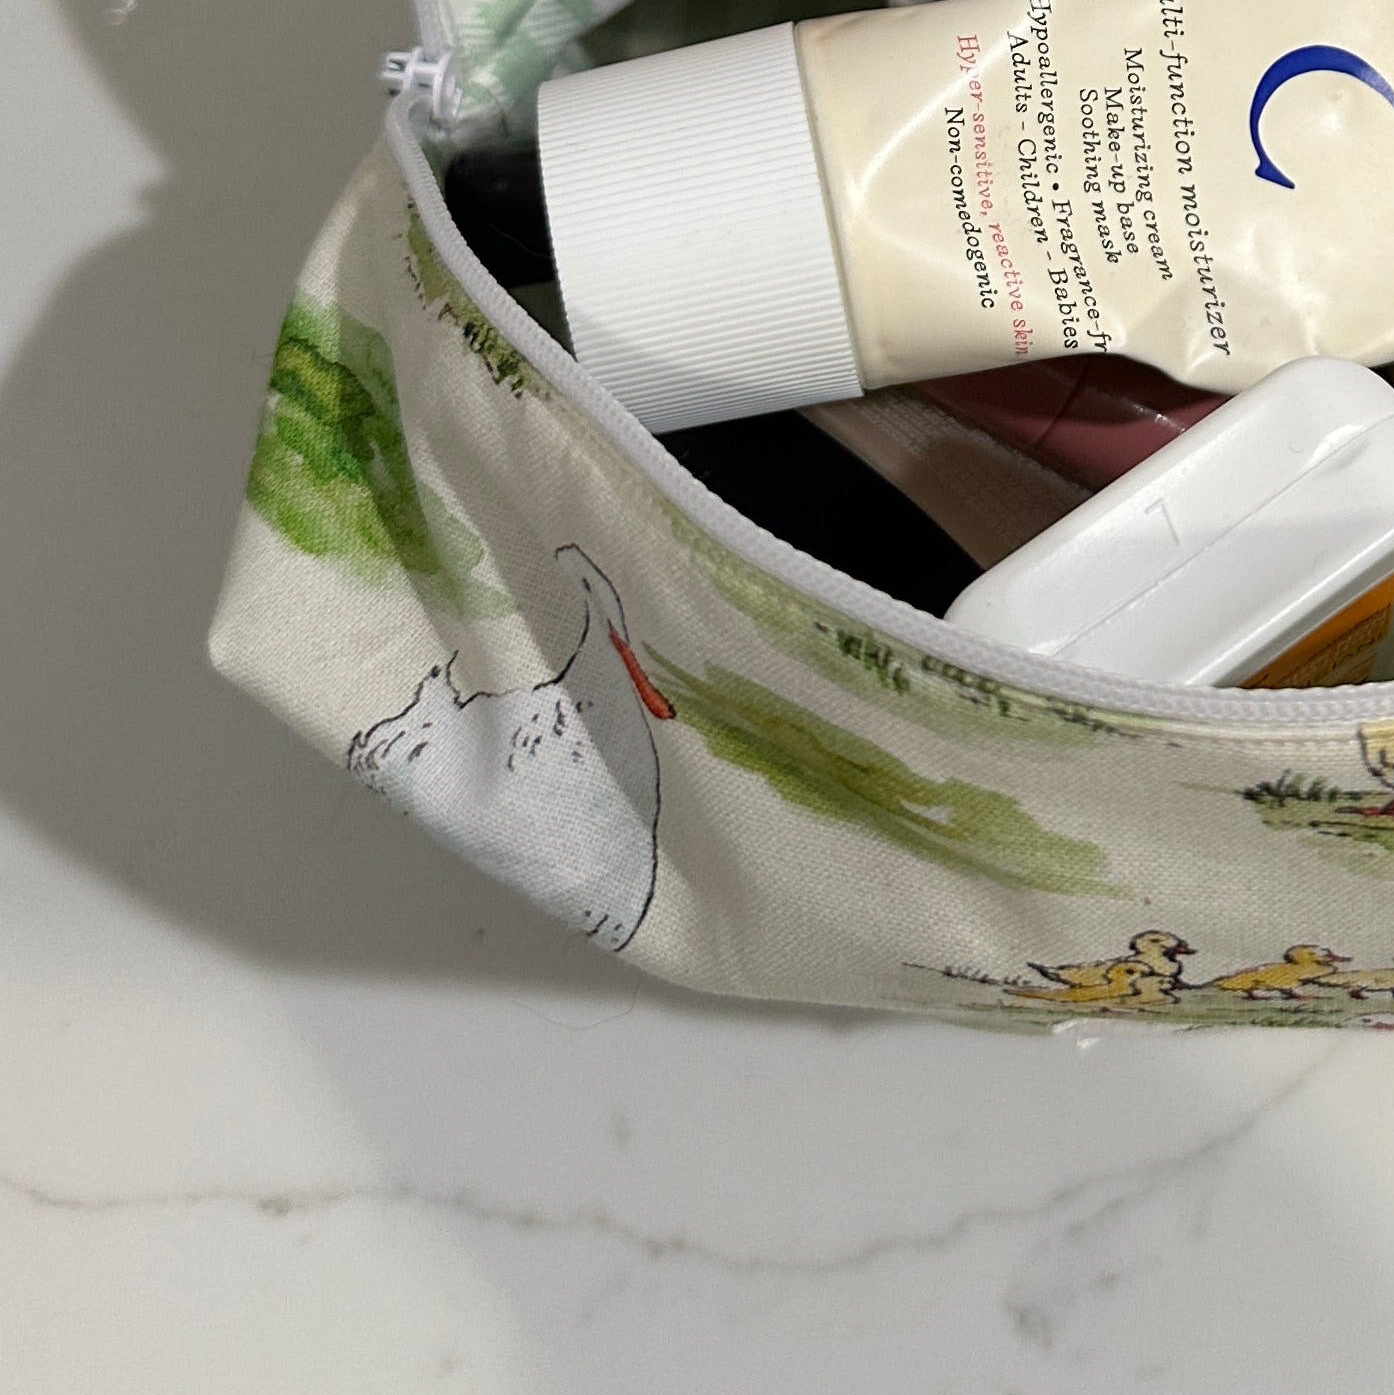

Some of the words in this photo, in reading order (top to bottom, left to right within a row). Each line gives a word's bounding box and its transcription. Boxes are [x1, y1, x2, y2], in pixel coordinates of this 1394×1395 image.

[1006, 31, 1030, 114] Adults
[943, 106, 997, 309] Non-comedogenic
[1016, 138, 1050, 244] Children
[1078, 89, 1101, 193] Soothing
[1091, 201, 1121, 264] mask
[1103, 87, 1125, 194] Make-up
[1115, 201, 1138, 254] base
[1123, 48, 1154, 203] Moisturizing
[1142, 210, 1172, 280] cream
[986, 222, 1025, 312] reactive
[1012, 319, 1033, 356] skin
[1046, 268, 1079, 349] Babies
[1179, 185, 1230, 356] moisturizer
